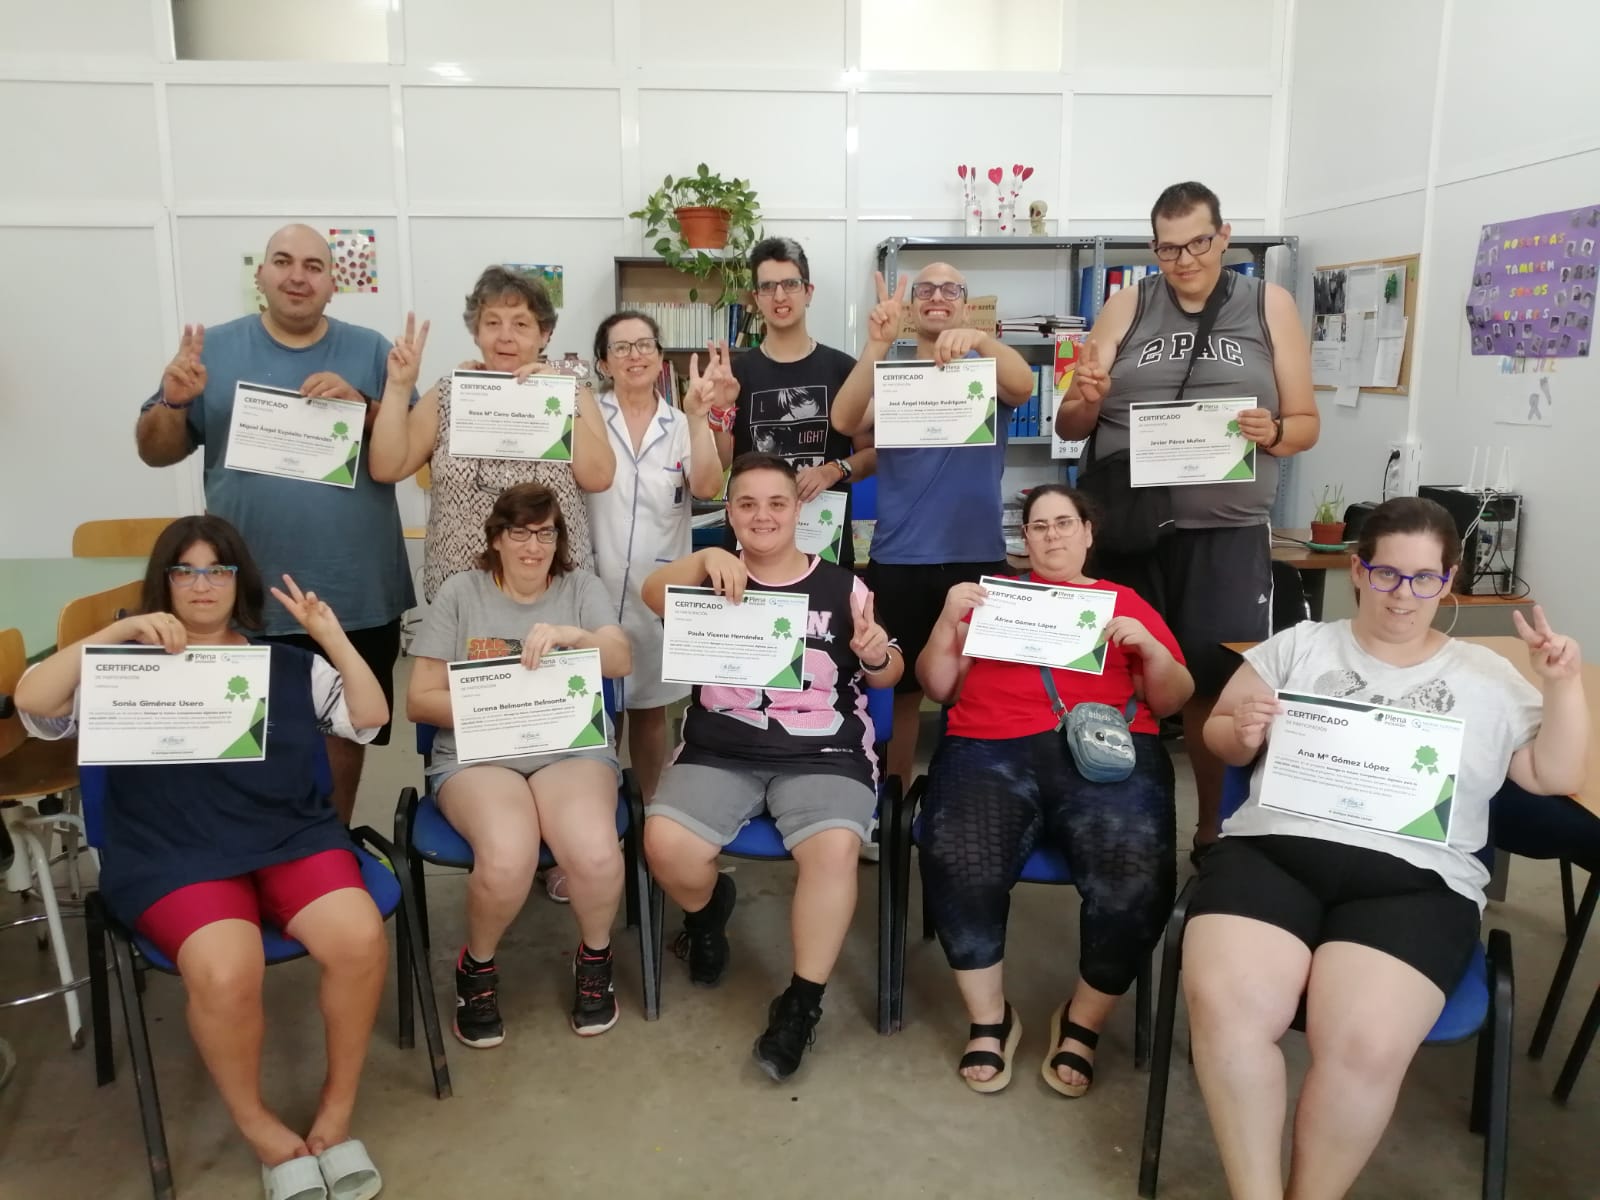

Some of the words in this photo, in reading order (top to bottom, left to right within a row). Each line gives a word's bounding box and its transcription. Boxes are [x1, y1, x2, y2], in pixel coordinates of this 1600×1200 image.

[459, 383, 502, 391] CERTIFICADO
[243, 396, 289, 409] CERTIFICADO
[760, 401, 765, 413] L
[1138, 414, 1181, 422] CERTIFICADO
[239, 422, 259, 431] Miguel
[798, 430, 825, 444] LIGHT
[986, 590, 1032, 602] CERTIFICADO
[674, 601, 723, 610] CERTIFICADO
[95, 663, 161, 673] CERTIFICADO
[459, 672, 512, 684] CERTIFICADO
[112, 699, 137, 708] Sonia
[139, 698, 176, 708] Giménez
[178, 699, 204, 708] Usero
[473, 704, 498, 713] Lorena
[499, 702, 533, 712] Belmonte
[534, 697, 567, 707] Belmonte
[1287, 709, 1349, 727] CERTIFICADO
[1384, 713, 1407, 724] Plena
[1297, 748, 1315, 759] Ana
[1317, 751, 1329, 760] Mª
[1331, 755, 1361, 767] Gómez
[1363, 760, 1390, 773] López
